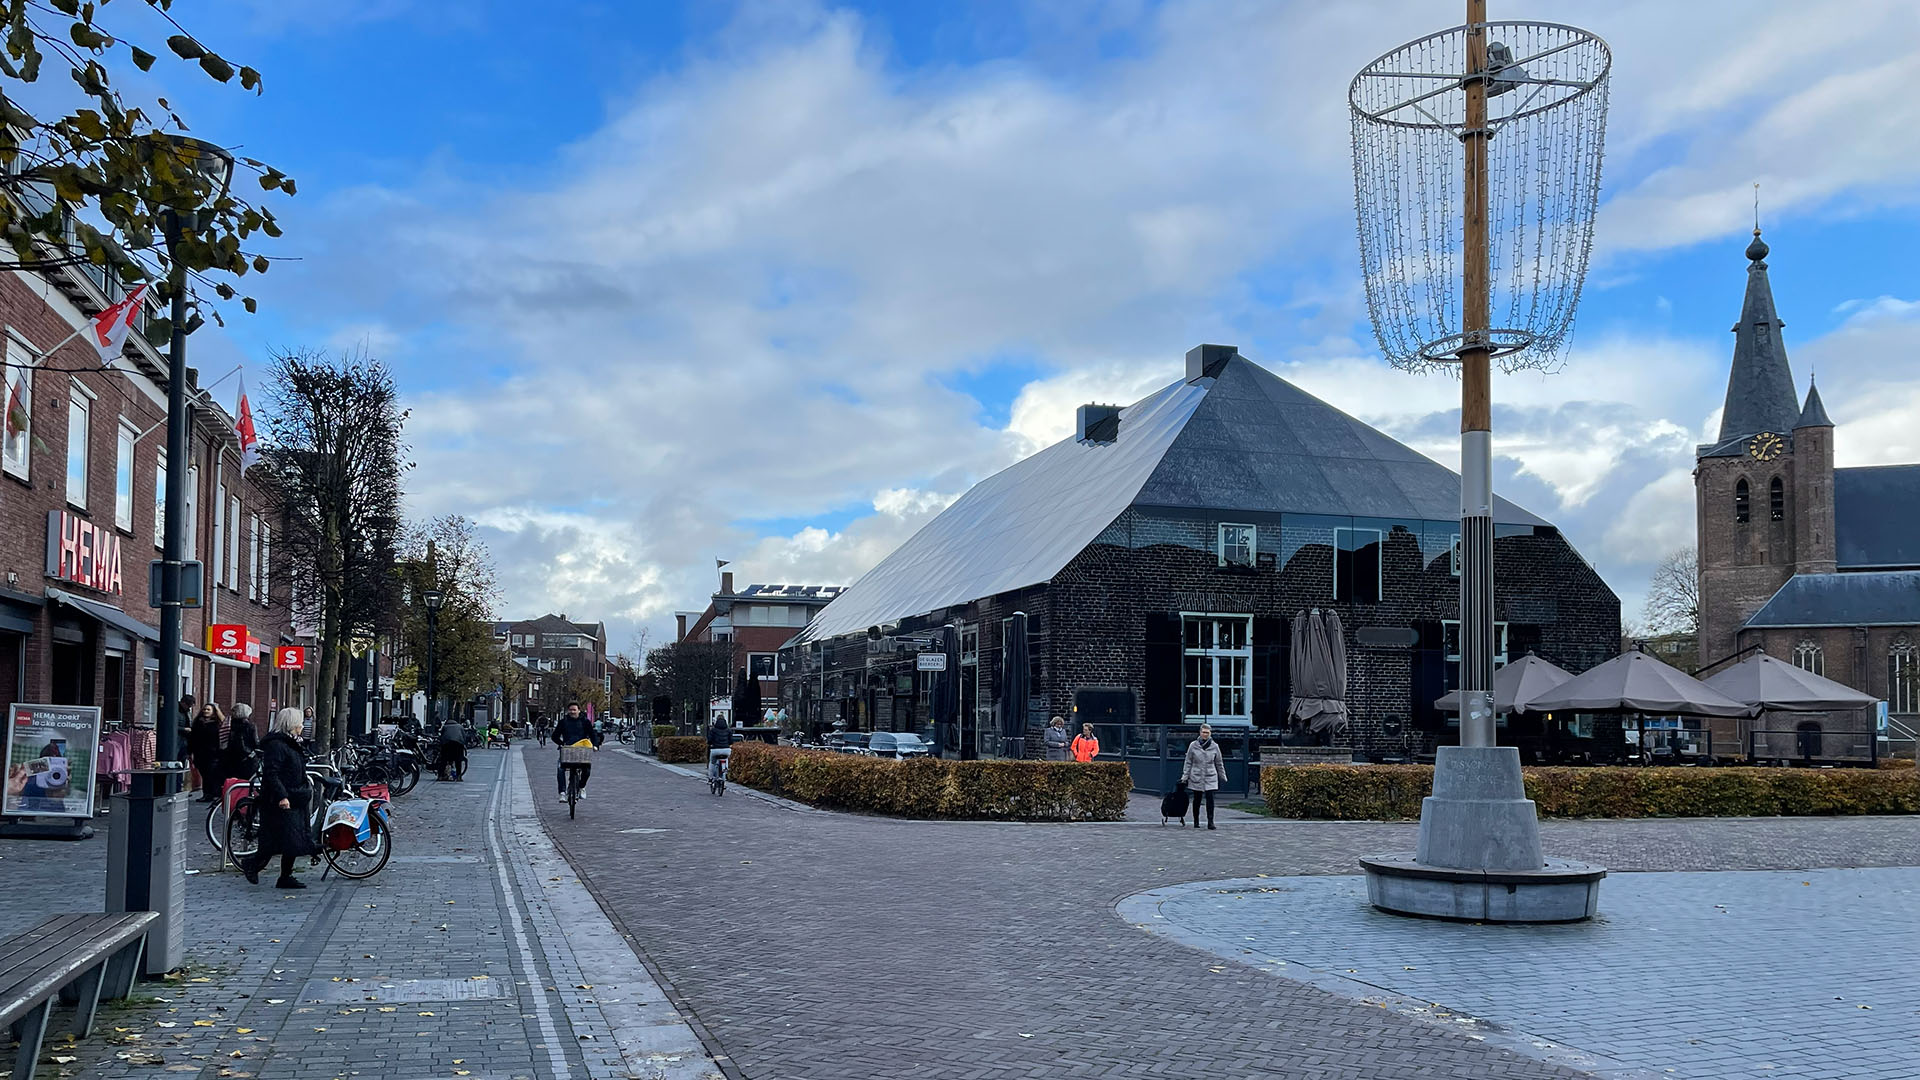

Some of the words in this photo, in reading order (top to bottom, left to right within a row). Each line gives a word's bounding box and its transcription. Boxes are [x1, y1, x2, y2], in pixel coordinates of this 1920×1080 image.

[60, 511, 122, 596] HEMA
[222, 630, 237, 647] S
[285, 650, 297, 664] S
[57, 722, 92, 730] collega's
